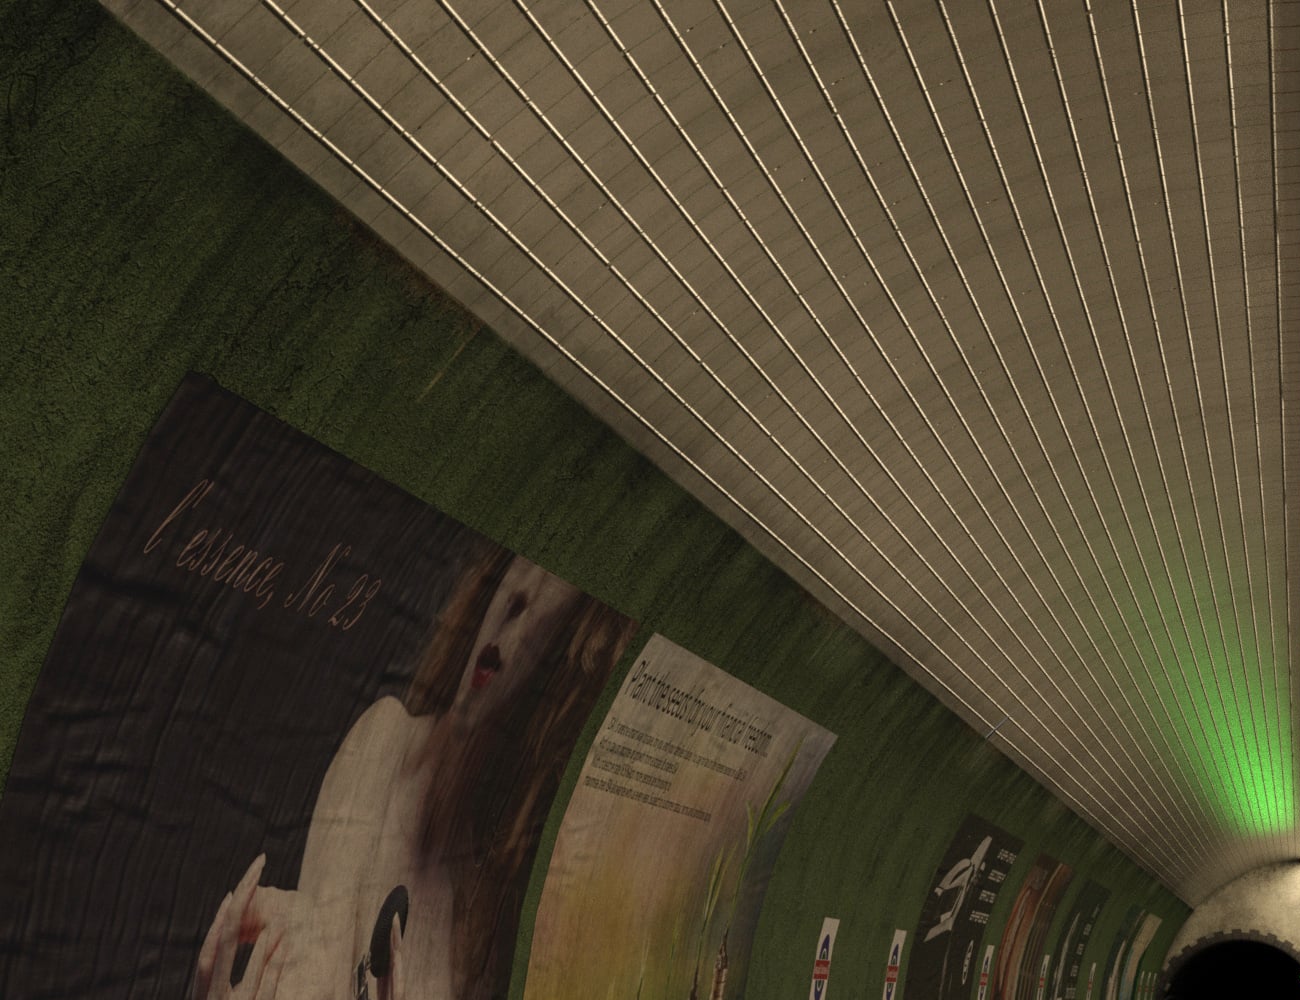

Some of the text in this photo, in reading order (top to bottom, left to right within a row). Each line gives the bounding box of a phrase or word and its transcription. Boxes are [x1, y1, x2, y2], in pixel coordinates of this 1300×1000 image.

[284, 542, 352, 617] No
[328, 573, 382, 630] 23
[624, 660, 660, 703] Plant
[648, 671, 673, 710] the
